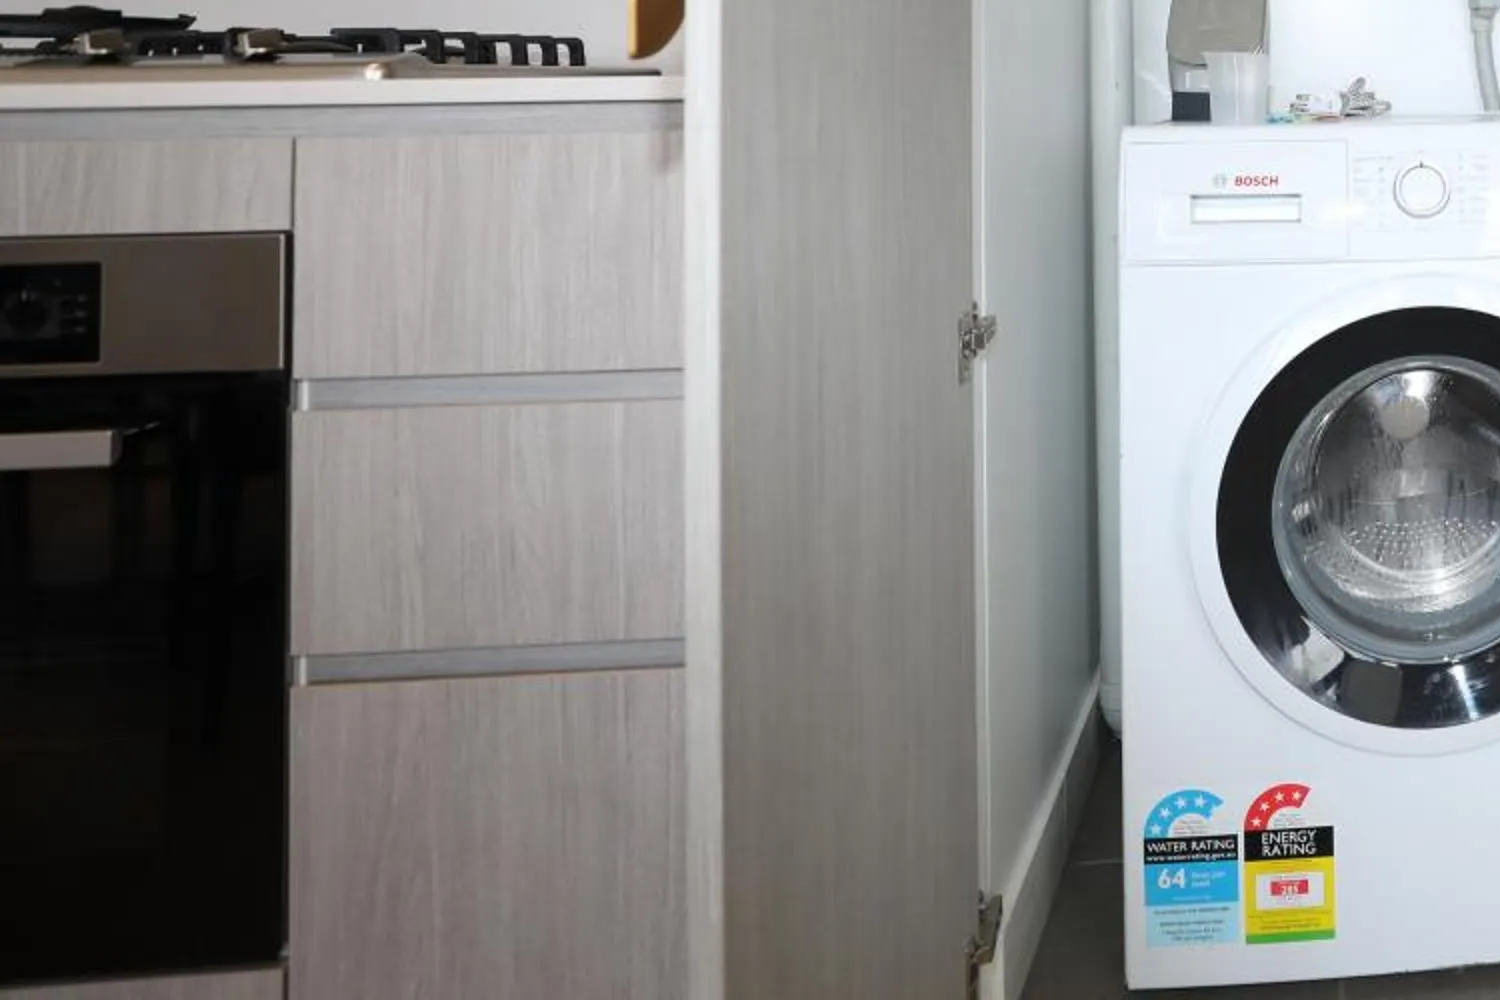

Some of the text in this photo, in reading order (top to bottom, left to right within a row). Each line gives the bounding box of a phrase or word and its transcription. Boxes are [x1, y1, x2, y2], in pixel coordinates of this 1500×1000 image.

[1234, 175, 1279, 187] BOSCH
[1261, 829, 1317, 845] ENERGY
[1147, 839, 1235, 853] WATER RATING
[1262, 842, 1317, 857] RATING
[1158, 867, 1186, 889] 64
